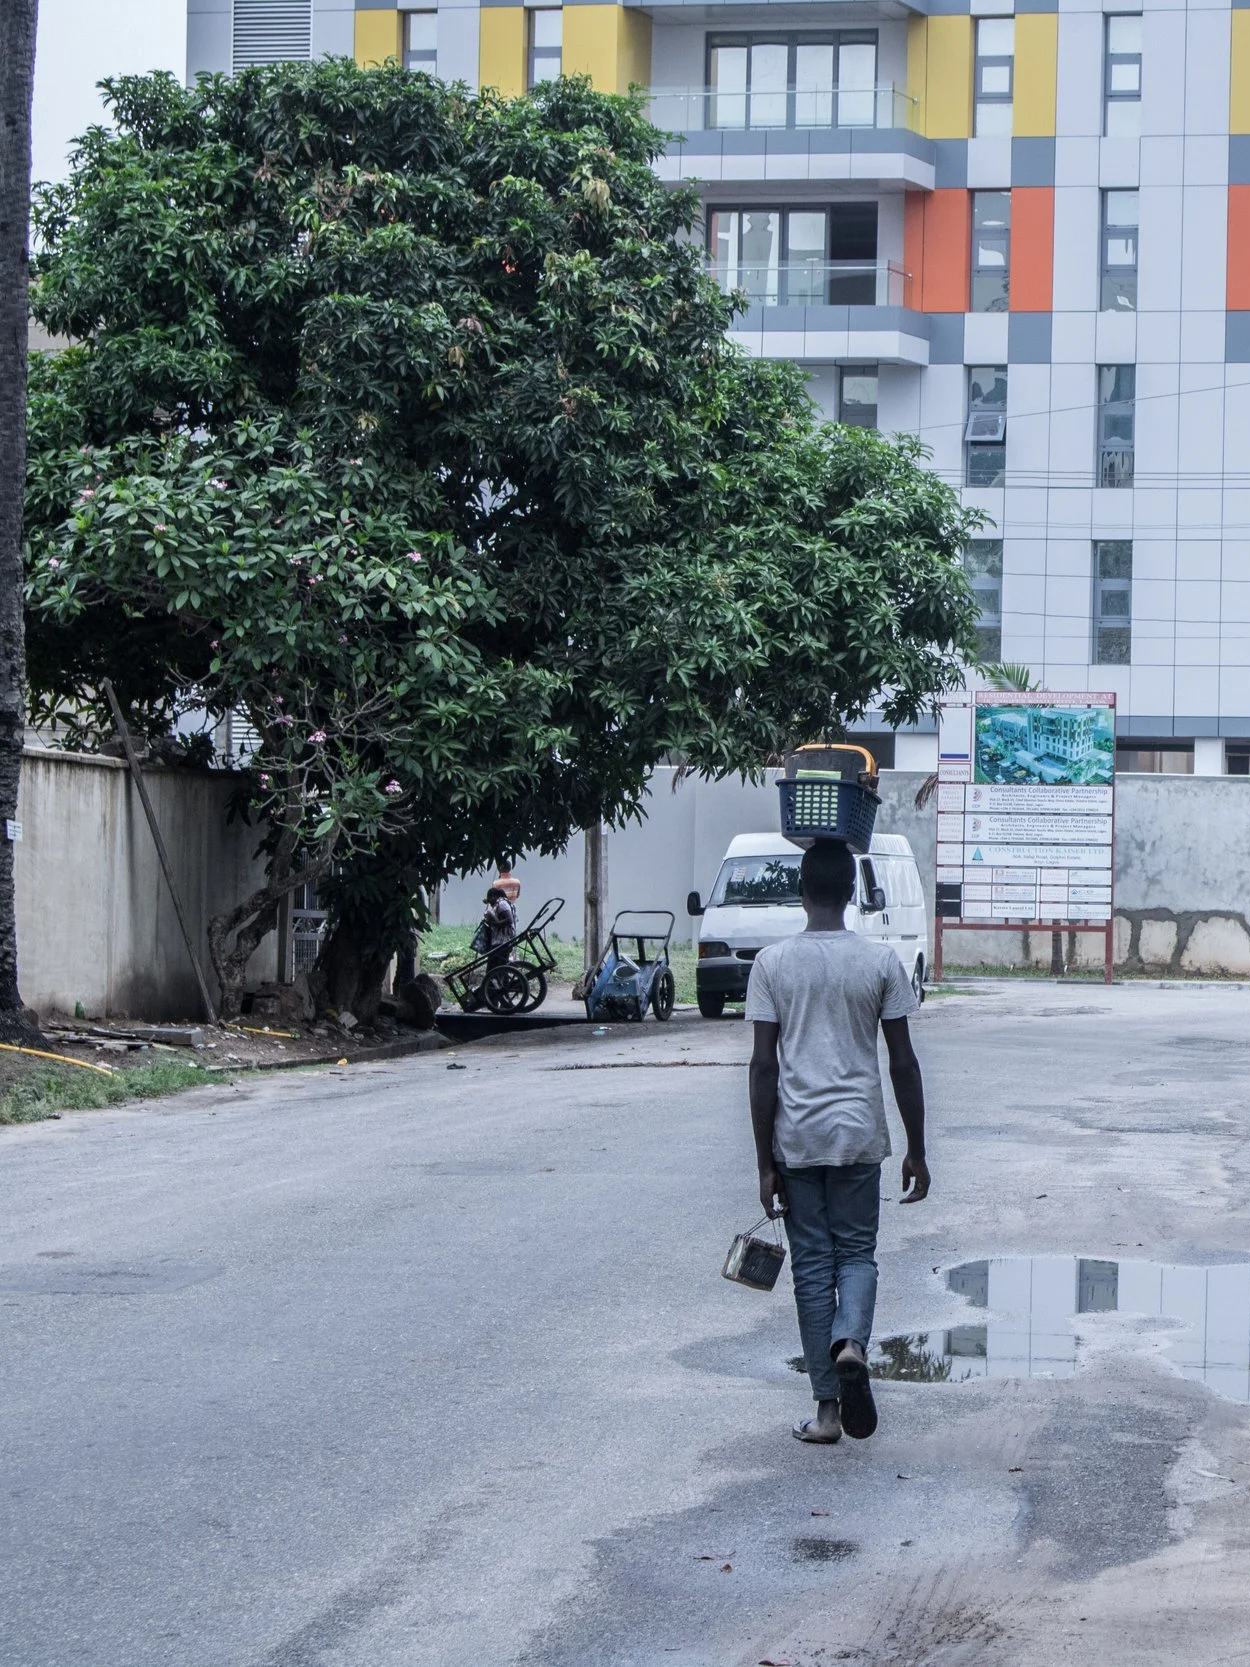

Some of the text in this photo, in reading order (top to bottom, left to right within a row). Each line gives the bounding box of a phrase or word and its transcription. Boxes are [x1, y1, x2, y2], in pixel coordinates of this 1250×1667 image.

[1028, 787, 1070, 795] Collaborative
[1071, 788, 1108, 796] Partnership
[1070, 818, 1107, 826] Partnership
